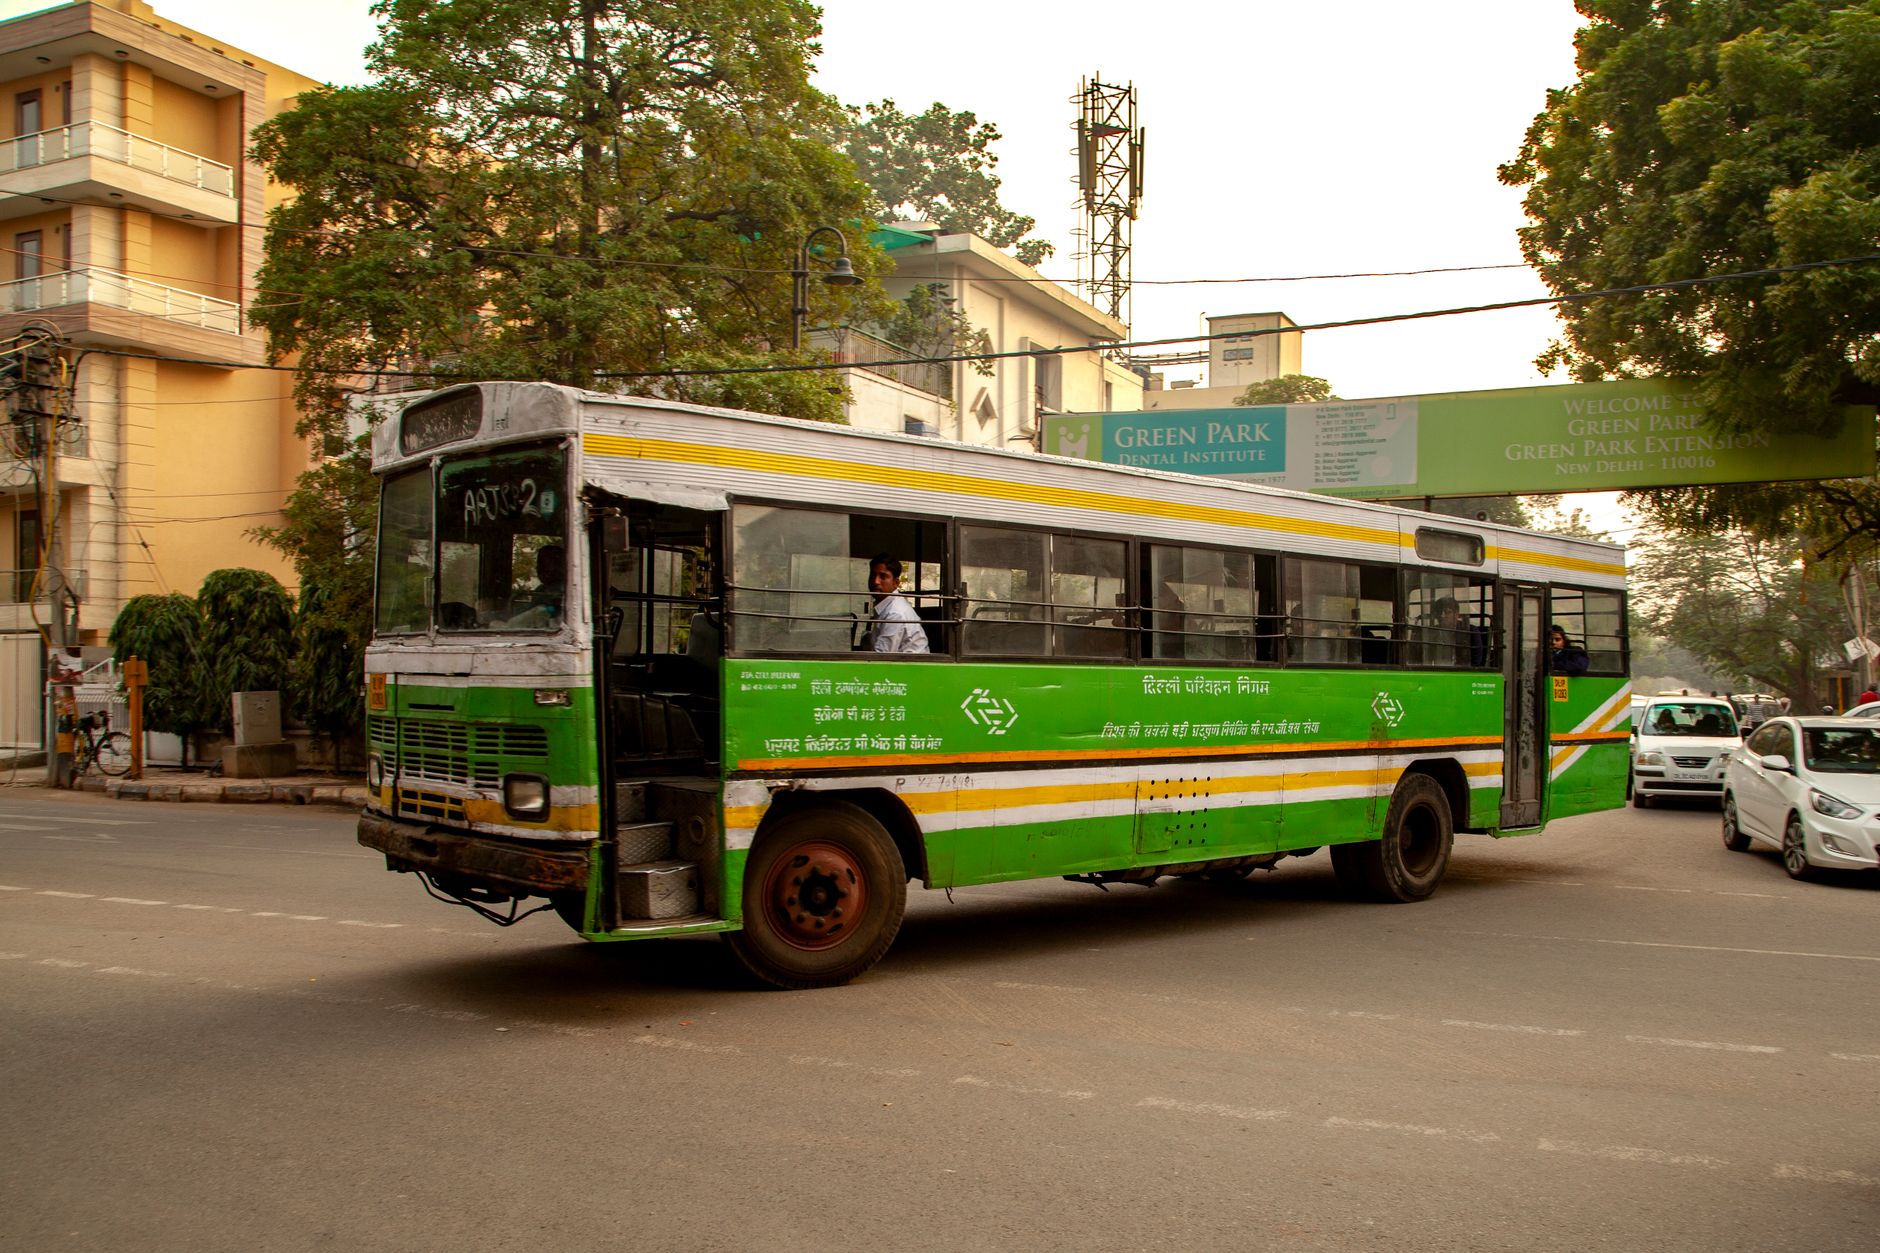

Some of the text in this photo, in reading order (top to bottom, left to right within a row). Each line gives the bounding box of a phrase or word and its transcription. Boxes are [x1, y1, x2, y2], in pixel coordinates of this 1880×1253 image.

[1563, 394, 1672, 416] WELCOME
[1114, 422, 1272, 448] GREEN PARK
[1568, 418, 1640, 436] GREEN
[1119, 449, 1266, 466] DENTAL INSTITUTE
[1504, 433, 1770, 462] GREEN PARK EXTENSION
[1556, 462, 1592, 475] NEW
[1596, 460, 1644, 473] DELHI
[1661, 456, 1716, 470] 110016
[1142, 675, 1270, 696] दिल्ली परिवहन निगम
[1128, 721, 1141, 737] की
